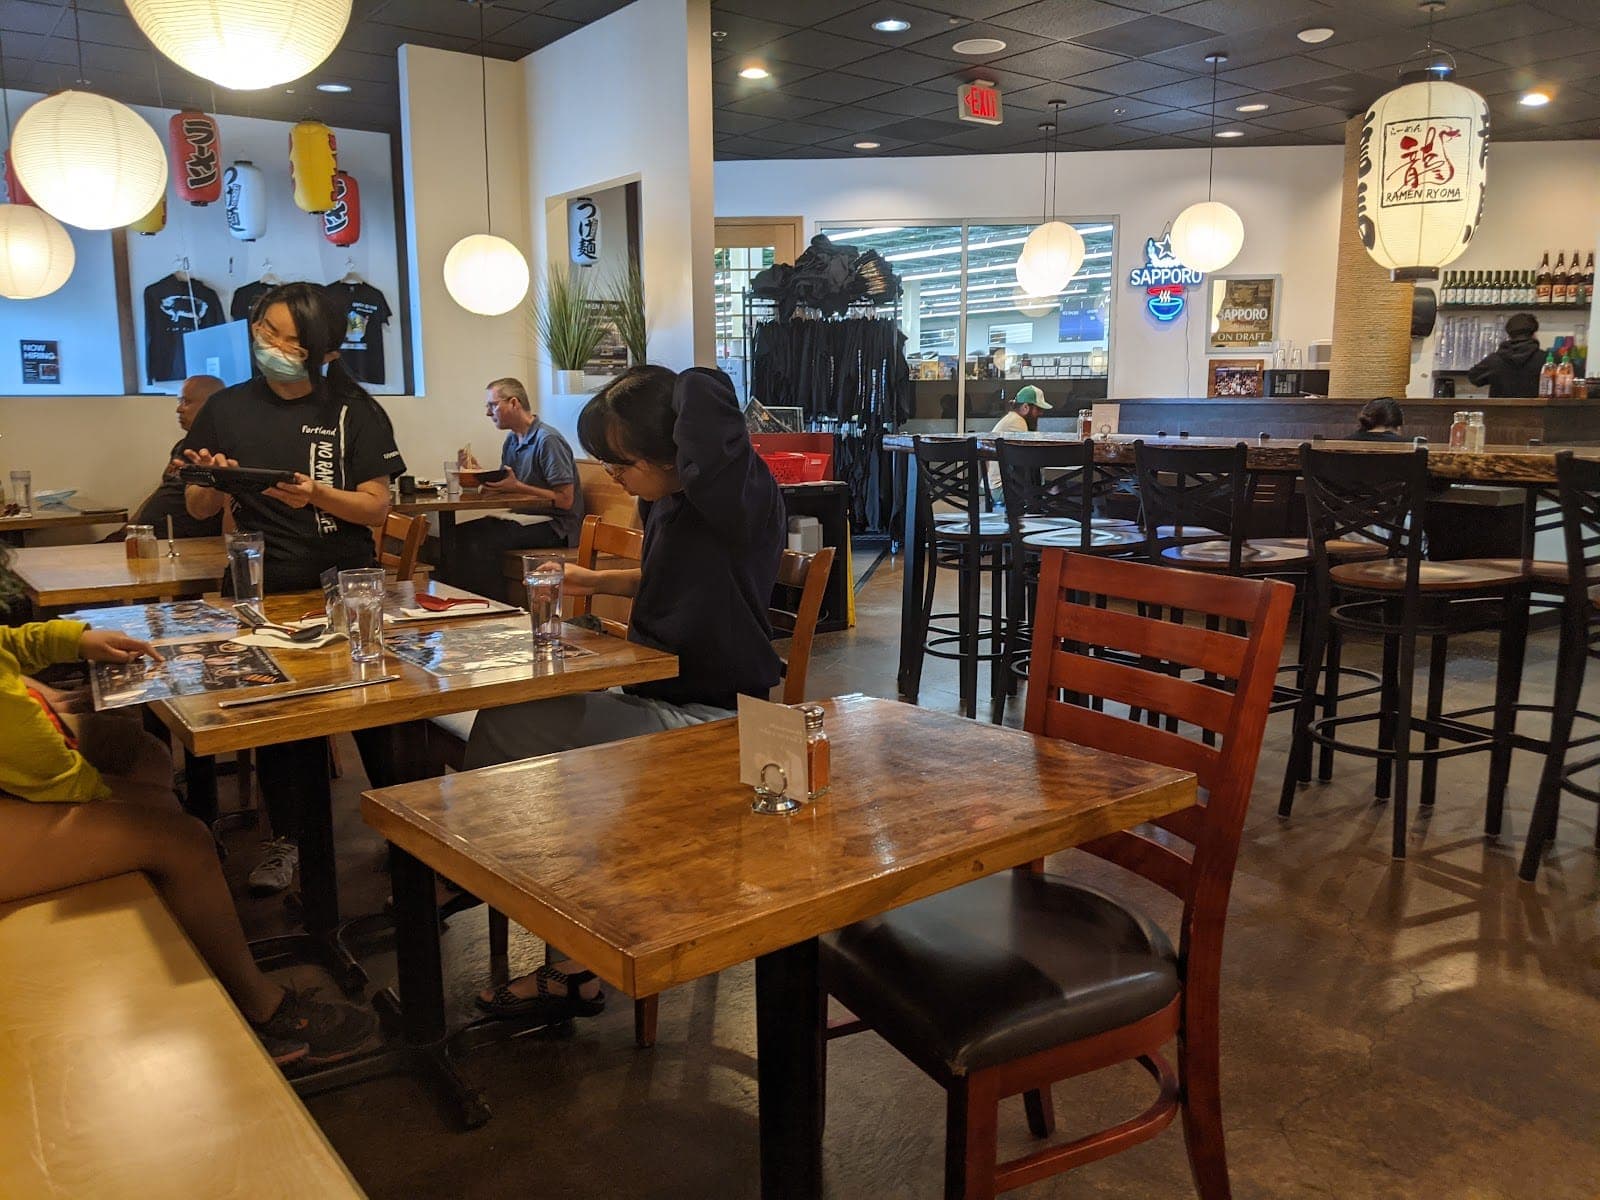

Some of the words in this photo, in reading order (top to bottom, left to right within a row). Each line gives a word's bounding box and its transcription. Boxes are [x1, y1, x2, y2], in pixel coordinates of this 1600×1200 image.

[971, 86, 997, 118] EXIT
[183, 119, 217, 189] ラーメン
[1386, 189, 1423, 202] RAMEN
[1426, 188, 1461, 199] RYOMA
[576, 202, 598, 260] つけ麺
[1130, 267, 1203, 286] SAPPORO
[1217, 307, 1268, 321] SAPPORO
[1217, 332, 1233, 341] ON
[1236, 332, 1266, 341] DRAFT
[23, 351, 56, 360] HIRING
[318, 441, 333, 459] NO
